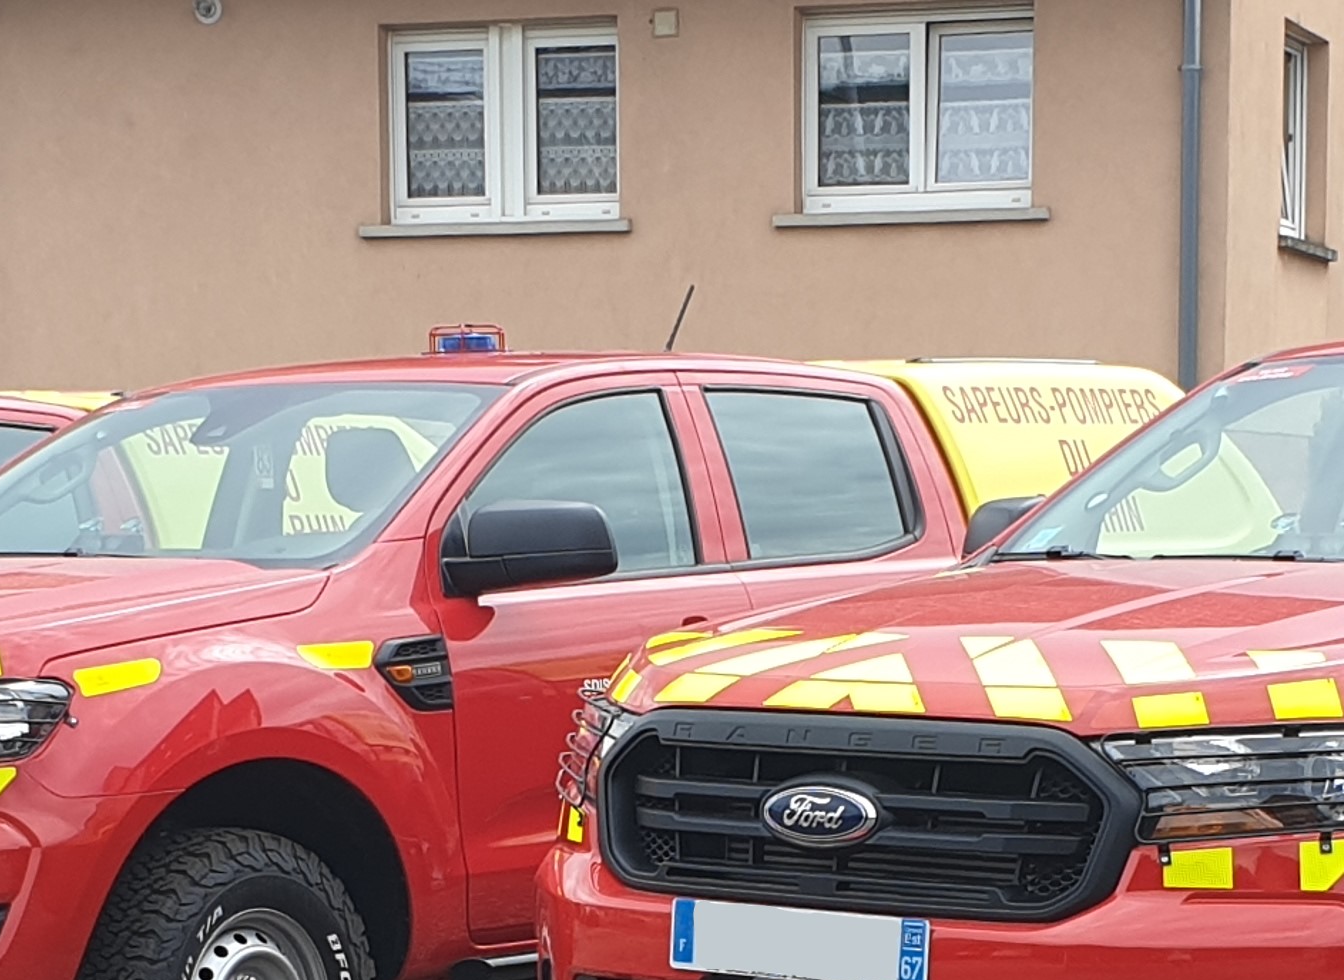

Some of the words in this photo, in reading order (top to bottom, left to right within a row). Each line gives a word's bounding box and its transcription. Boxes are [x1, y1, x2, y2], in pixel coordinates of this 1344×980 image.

[942, 385, 1162, 425] SAPEURS-POMPIERS
[1058, 439, 1092, 477] DU
[673, 722, 1006, 754] RANGER
[783, 794, 845, 829] Ford
[900, 956, 922, 980] 67
